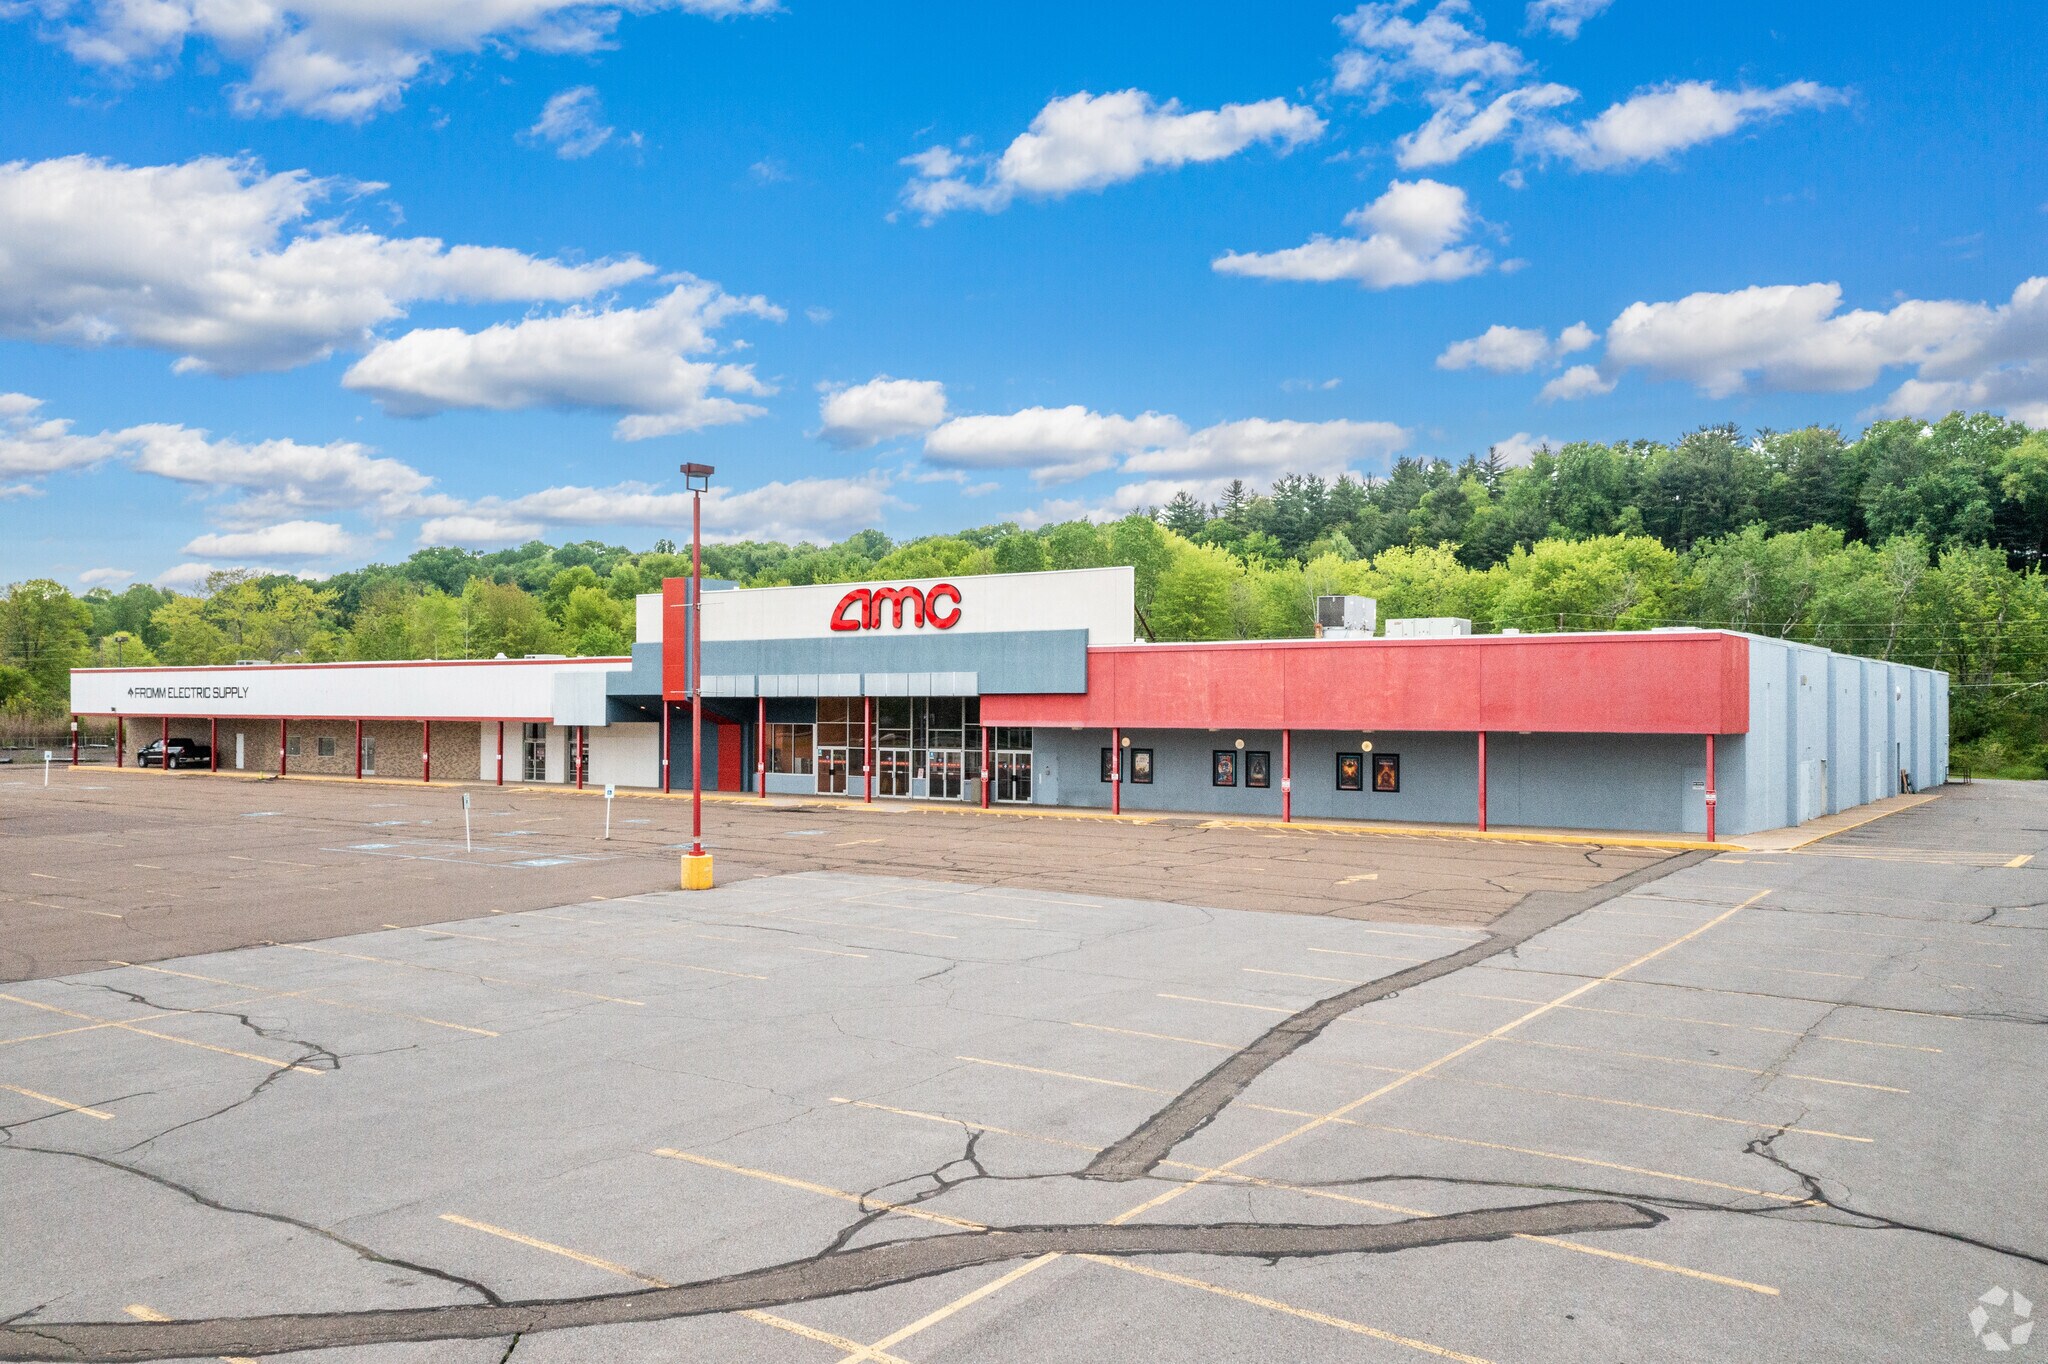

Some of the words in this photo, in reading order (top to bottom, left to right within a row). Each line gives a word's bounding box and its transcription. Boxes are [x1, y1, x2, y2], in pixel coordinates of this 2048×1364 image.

[134, 687, 166, 699] FROMM
[168, 687, 211, 699] ELECTRIC
[212, 686, 249, 699] SUPPLY
